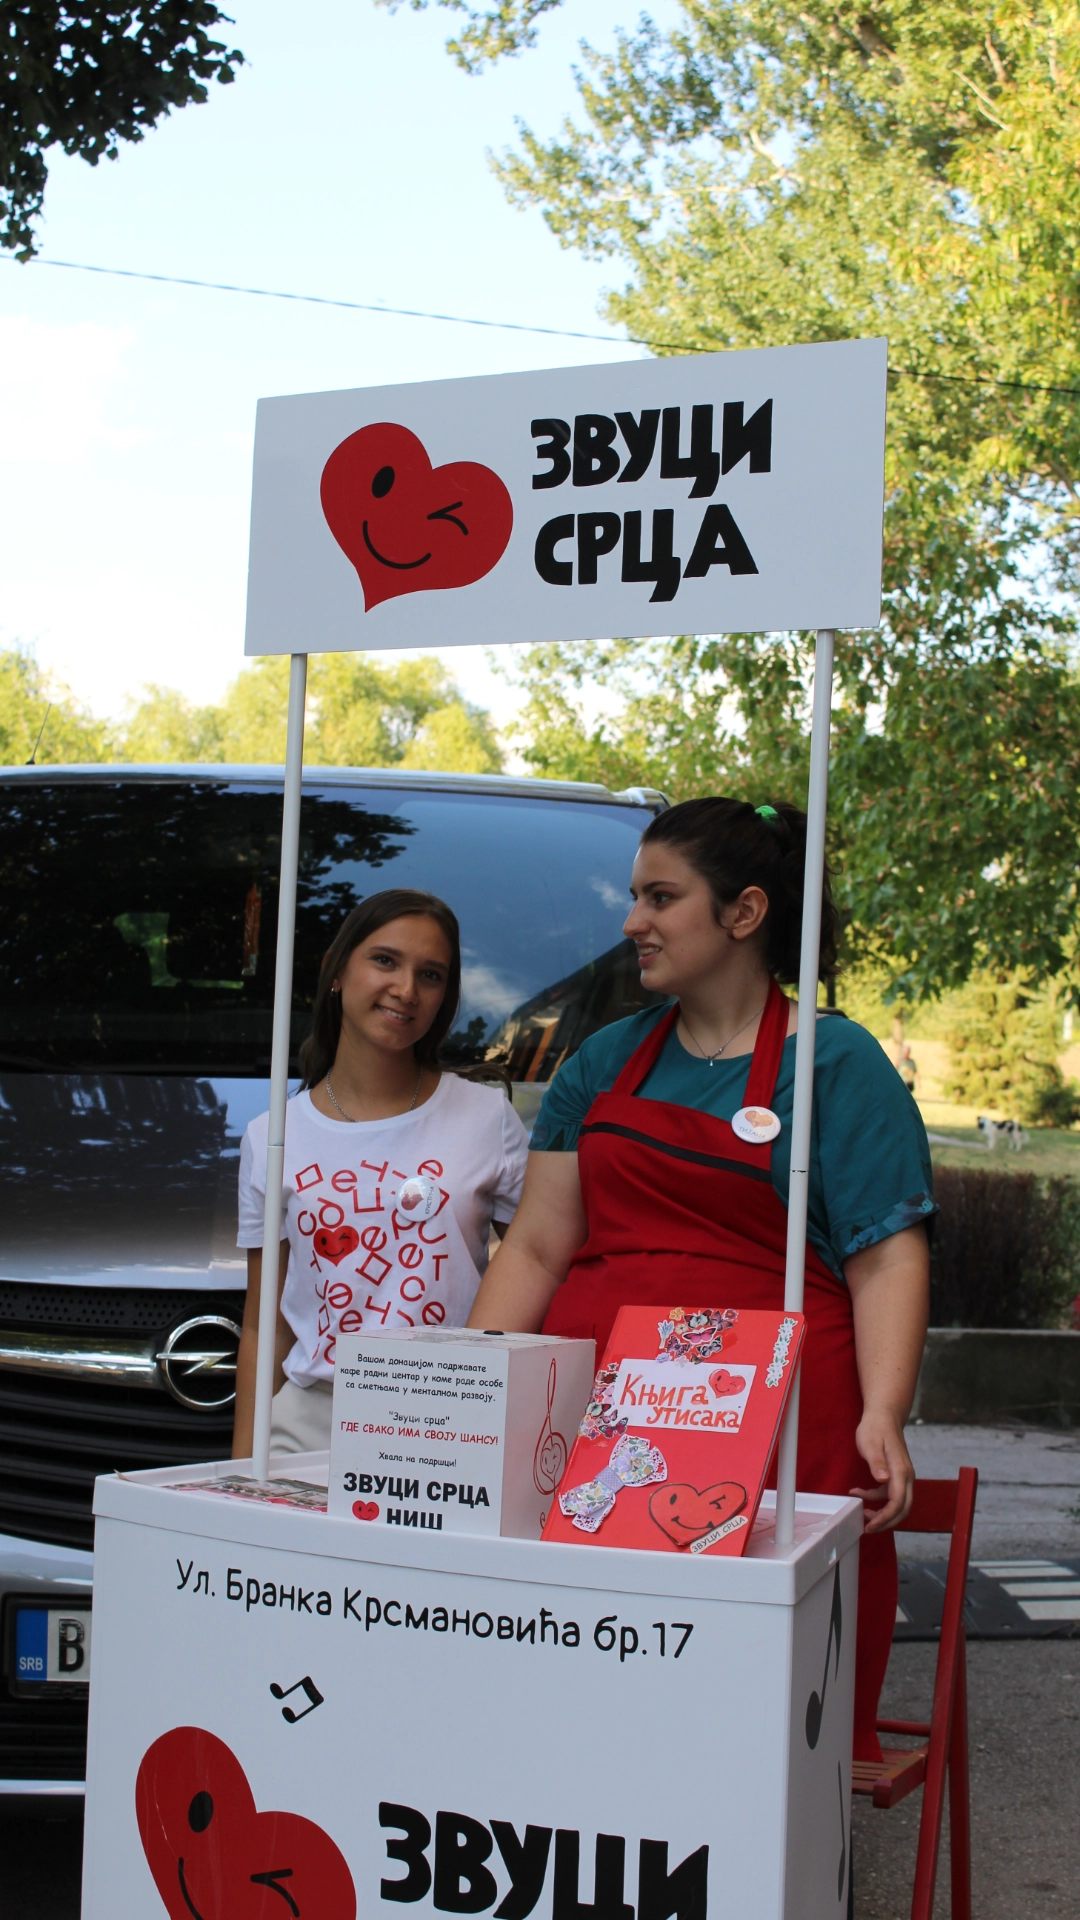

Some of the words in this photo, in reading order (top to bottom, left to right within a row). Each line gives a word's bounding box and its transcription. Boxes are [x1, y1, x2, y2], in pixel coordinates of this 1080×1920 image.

[531, 397, 774, 499] ЗВУЦИ
[534, 504, 760, 602] СРЦА
[340, 1367, 361, 1378] кафе
[363, 1369, 389, 1379] радни
[391, 1372, 420, 1383] центар
[423, 1375, 429, 1384] у
[431, 1375, 453, 1384] коме
[455, 1377, 476, 1387] раде
[478, 1379, 504, 1388] особе
[357, 1353, 386, 1365] Вашом
[388, 1358, 434, 1370] донацијом
[437, 1362, 487, 1373] подржавате
[345, 1381, 355, 1389] са
[358, 1382, 400, 1393] сметњама
[402, 1387, 408, 1396] у
[410, 1388, 458, 1398] менталном
[461, 1391, 496, 1403] развоју.
[619, 1373, 709, 1407] Книга
[340, 1421, 359, 1433] ГДЕ
[362, 1423, 395, 1436] СВАКО
[397, 1426, 421, 1438] ИМА
[424, 1429, 457, 1442] СВОЈУ
[460, 1432, 499, 1446] ШАНСУ!
[378, 1451, 403, 1462] Хвала
[418, 1457, 457, 1468] подршци!
[343, 1472, 420, 1501] ЗВУЦИ
[426, 1481, 490, 1509] СРЦА
[386, 1507, 443, 1530] НИШ
[691, 1531, 721, 1553] ЗВУЦИ
[722, 1516, 746, 1533] СРЦА
[176, 1558, 216, 1597] Ул.
[226, 1567, 332, 1613] Бранка
[343, 1586, 581, 1647] Крсмановића
[19, 1656, 43, 1671] SRB
[378, 1800, 710, 1920] ЗВУЦИ
